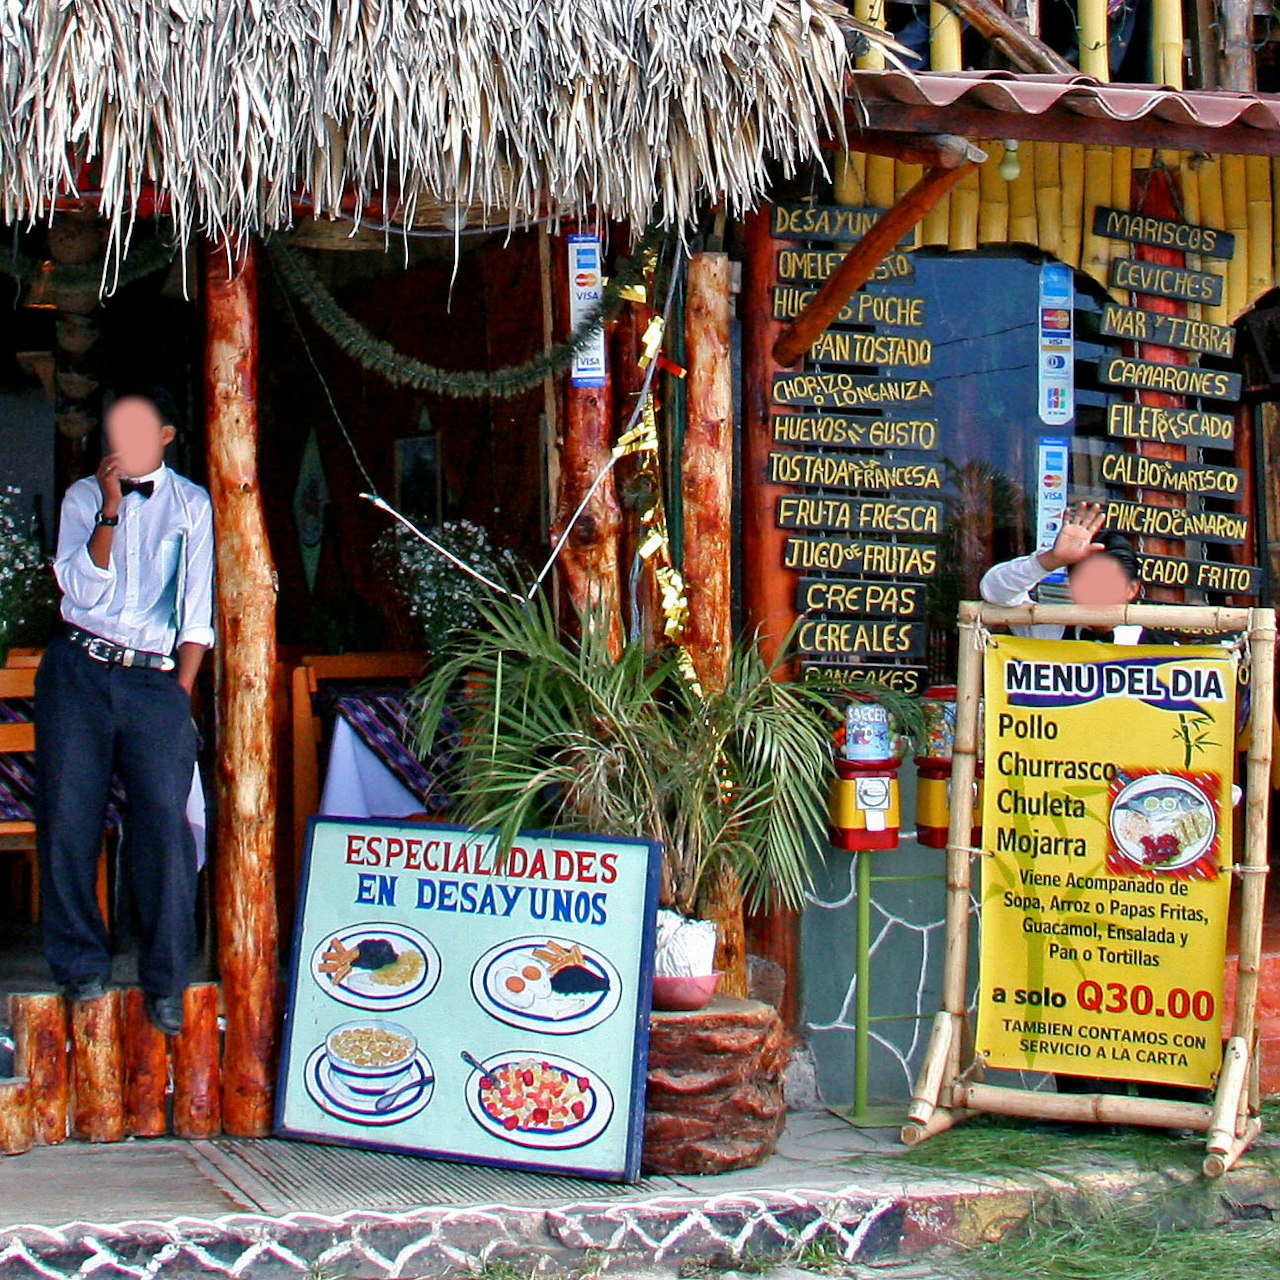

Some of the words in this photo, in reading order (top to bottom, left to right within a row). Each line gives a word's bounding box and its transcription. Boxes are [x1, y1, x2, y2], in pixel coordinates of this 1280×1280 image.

[1106, 211, 1218, 253] MARISCOS
[576, 291, 599, 301] VISA
[1116, 261, 1217, 300] CEVICHES
[859, 294, 926, 326] POCHE
[1104, 307, 1147, 339] MAR
[1167, 317, 1233, 357] TIERRA
[579, 357, 601, 366] VISA
[811, 333, 850, 363] PAN
[853, 335, 932, 367] TOSTADO
[773, 373, 853, 403] CHORIZO
[833, 379, 933, 408] LONGANIZA
[1109, 359, 1230, 396] CAMARONES
[775, 416, 848, 444] HUEVOS
[869, 421, 936, 450] GUSTO
[1110, 404, 1163, 439] FILET
[1157, 412, 1234, 443] PESCADO
[770, 452, 850, 487] TOSTADA
[853, 465, 941, 489] FRANCESA
[1162, 469, 1240, 493] MARISCO
[1043, 491, 1063, 501] VISA
[779, 499, 851, 529] FRUTA
[859, 502, 938, 533] FRESCA
[1105, 502, 1172, 534] PINCHO
[1172, 513, 1248, 540] CAMARON
[785, 538, 844, 569] JUGO
[843, 543, 863, 560] DE
[863, 545, 937, 576] FRUTAS
[1197, 564, 1251, 592] FRITO
[807, 583, 917, 615] CREPAS
[799, 622, 912, 654] CEREALES
[1006, 662, 1096, 694] MENU
[1104, 667, 1162, 697] DEL
[1171, 669, 1224, 699] DIA
[998, 713, 1058, 740] Pollo
[997, 750, 1117, 782] Churrasco
[996, 789, 1086, 819] Chuleta
[996, 827, 1087, 860] Mojarra
[354, 872, 399, 908] EN
[415, 877, 609, 927] DESAYUNOS
[1019, 869, 1061, 888] Viene
[1065, 871, 1165, 897] Acompañado
[1169, 879, 1189, 897] de
[1003, 892, 1046, 913] Sopa,
[1049, 895, 1091, 915] Arroz
[1095, 903, 1105, 915] o
[1109, 901, 1156, 921] Papas
[1159, 903, 1209, 925] Fritas,
[1022, 917, 1103, 941] Guacamol,
[1106, 924, 1176, 945] Ensalada
[1178, 933, 1189, 948] y
[1048, 943, 1078, 962] Pan
[1082, 950, 1093, 963] o
[1096, 947, 1161, 967] Tortillas
[991, 986, 1007, 1004] a
[1013, 986, 1067, 1009] solo
[1076, 979, 1215, 1022] Q30.00
[1001, 1018, 1074, 1038] TAMBIEN
[1077, 1025, 1169, 1046] CONTAMOS
[1172, 1033, 1207, 1050] CON
[1019, 1038, 1092, 1058] SERVICIO
[1096, 1047, 1108, 1059] A
[1111, 1047, 1132, 1062] LA
[1135, 1049, 1189, 1067] CARTA
